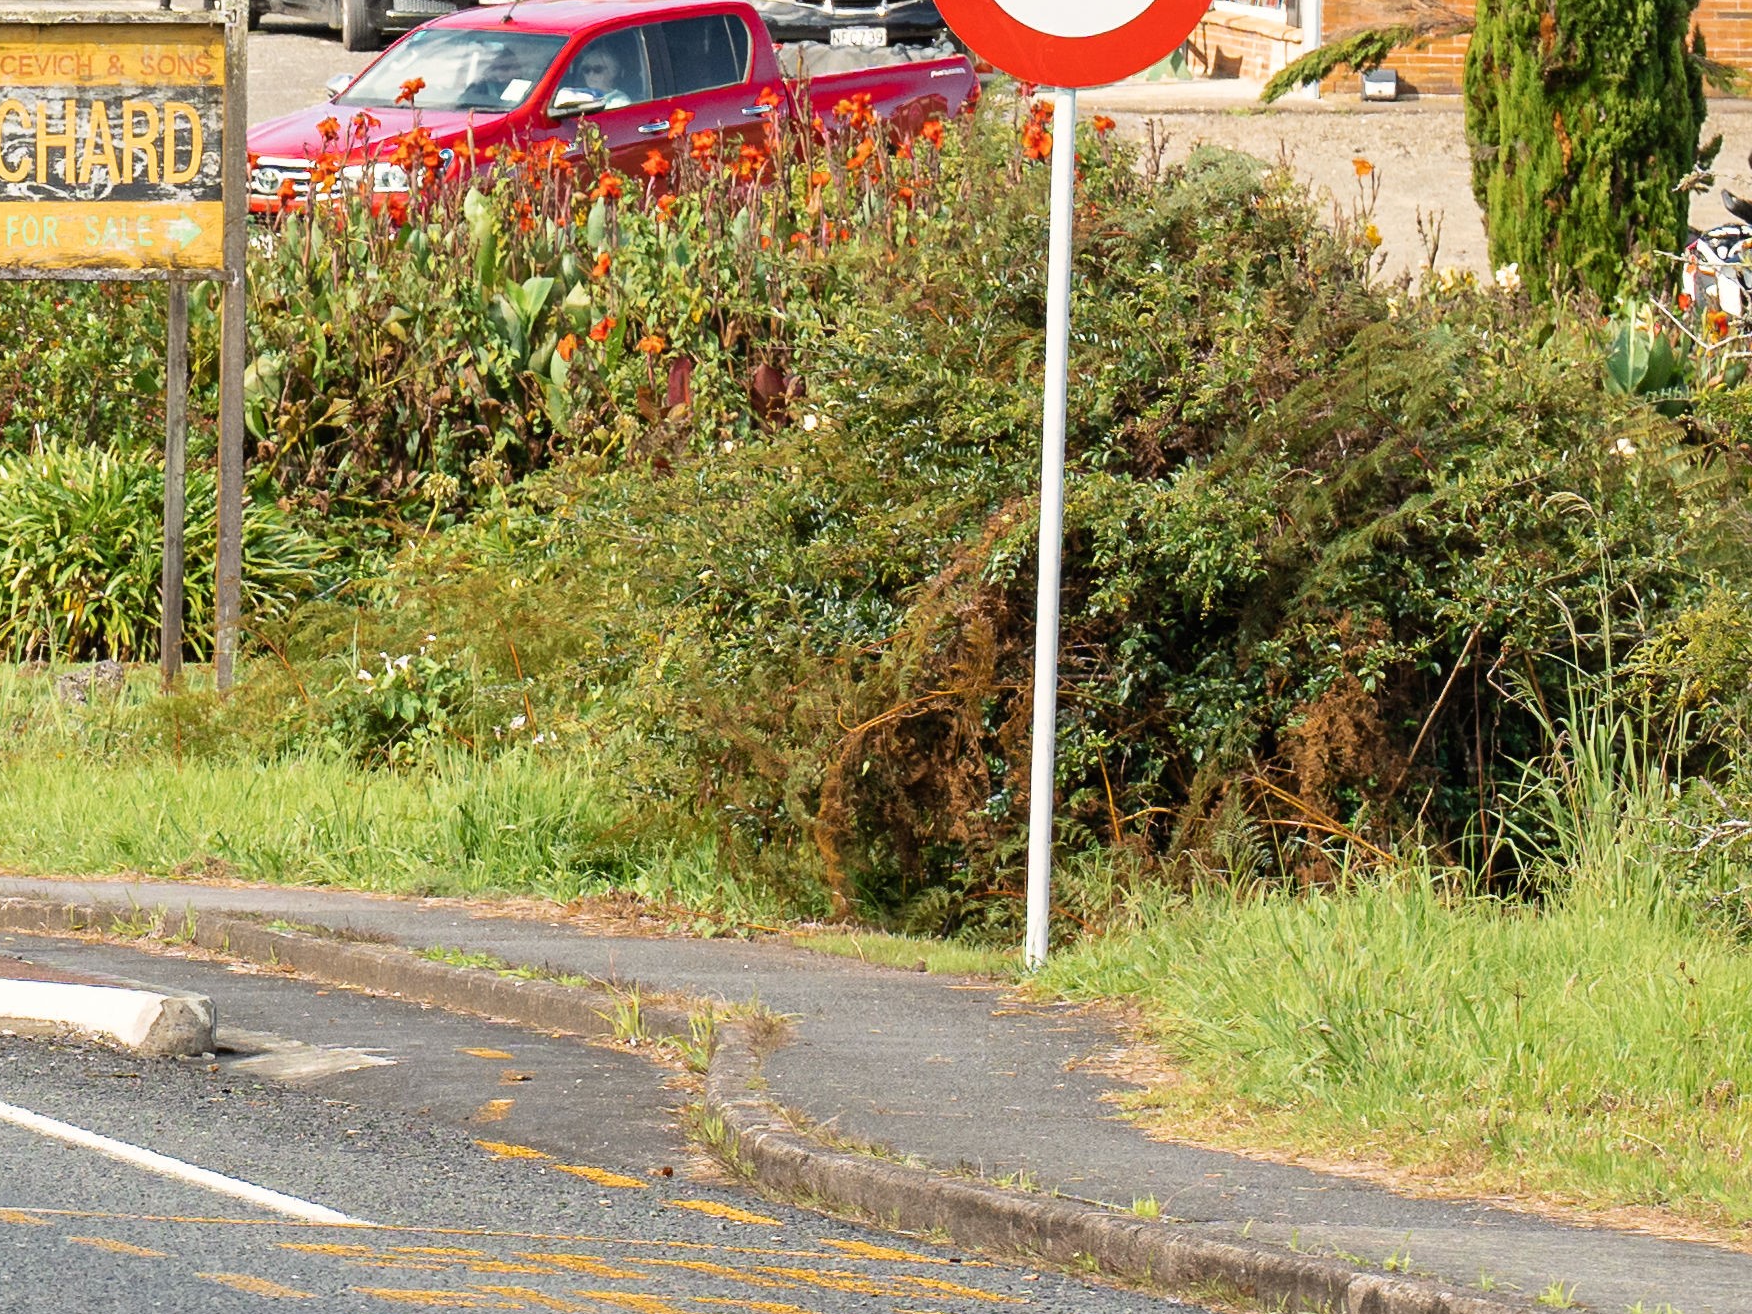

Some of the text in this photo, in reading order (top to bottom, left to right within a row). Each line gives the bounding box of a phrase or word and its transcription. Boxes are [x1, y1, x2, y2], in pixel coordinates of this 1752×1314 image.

[106, 55, 124, 77] &
[6, 215, 61, 247] FOR
[84, 215, 154, 247] SALE
